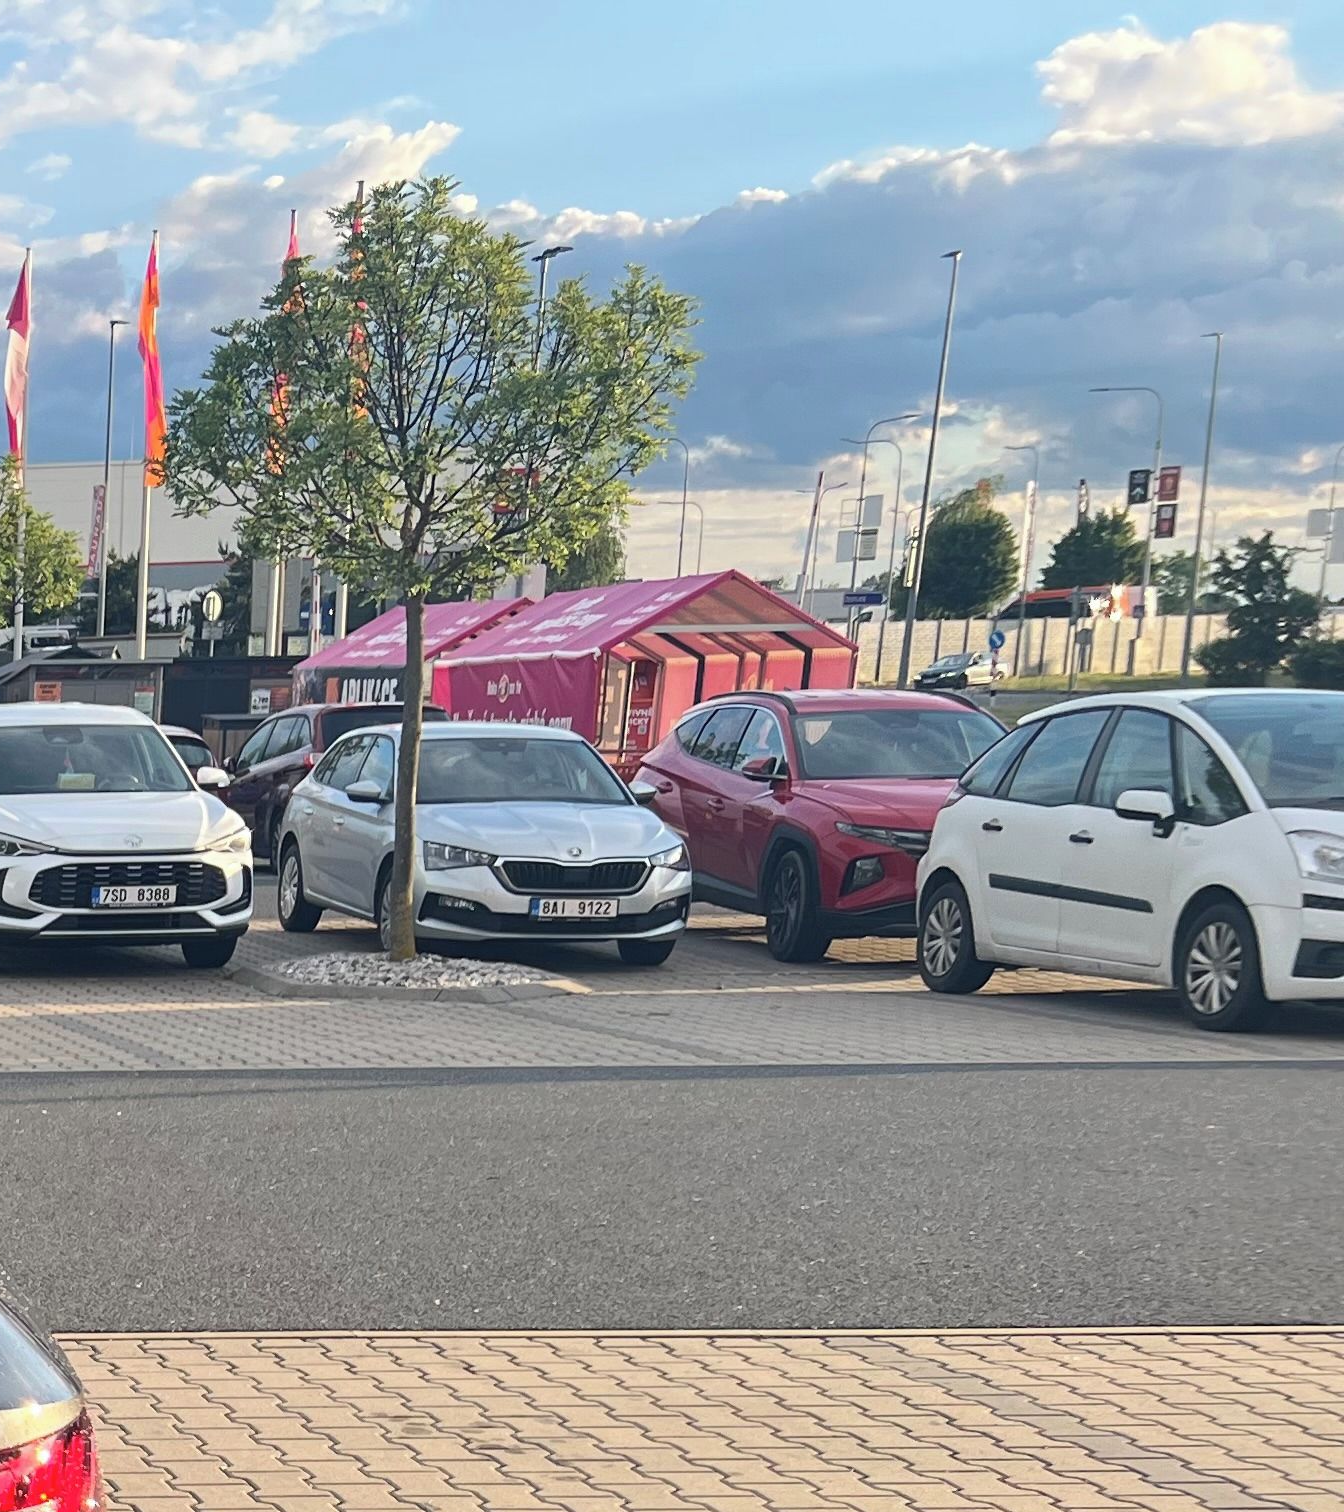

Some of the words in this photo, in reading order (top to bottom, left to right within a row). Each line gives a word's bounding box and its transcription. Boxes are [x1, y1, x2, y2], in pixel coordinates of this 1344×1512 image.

[102, 888, 128, 903] 7SD
[137, 887, 170, 902] 8388
[542, 901, 566, 915] 8AI
[577, 901, 612, 915] 9122
